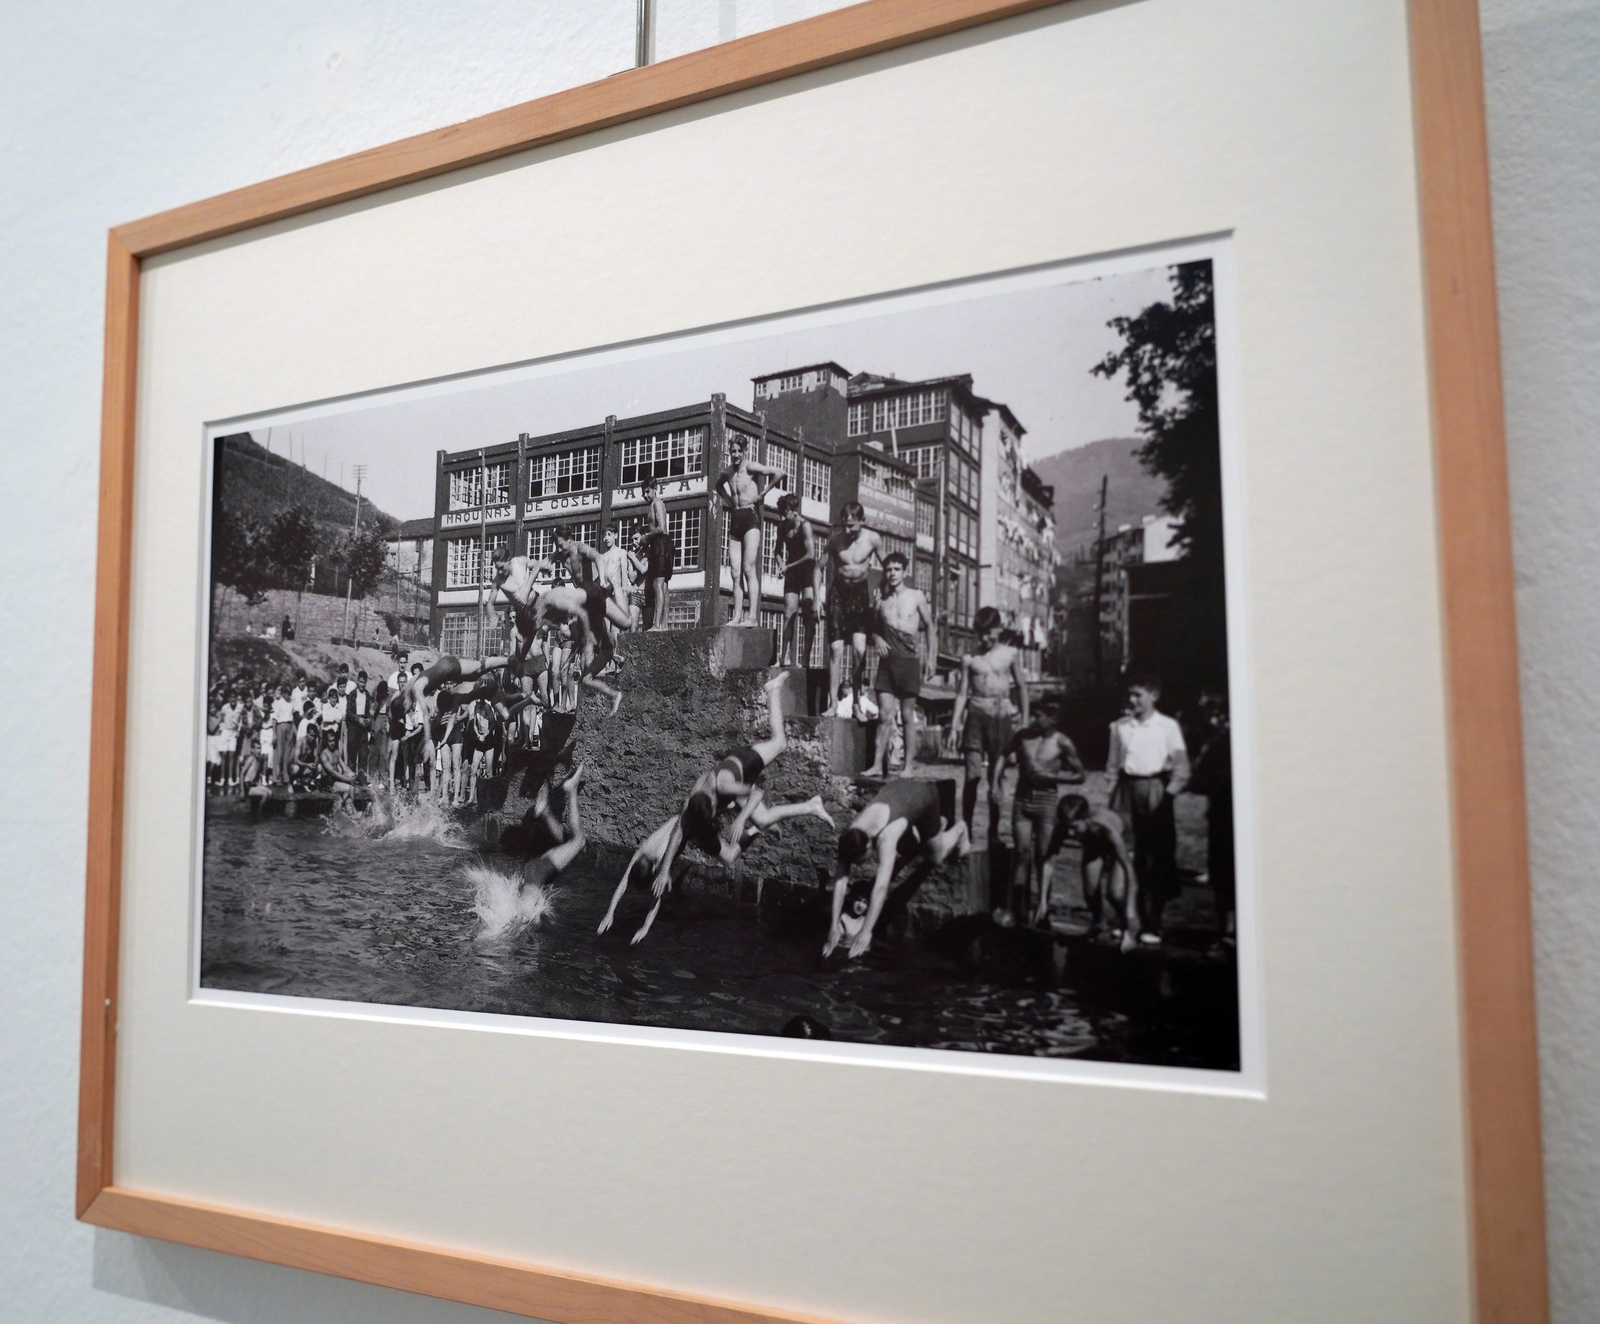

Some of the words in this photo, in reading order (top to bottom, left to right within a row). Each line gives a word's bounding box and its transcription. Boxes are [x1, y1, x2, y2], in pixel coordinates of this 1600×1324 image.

[446, 507, 511, 524] MAQUNAS
[525, 501, 543, 513] DE
[550, 493, 600, 510] COSER
[617, 477, 704, 500] "AFA"
